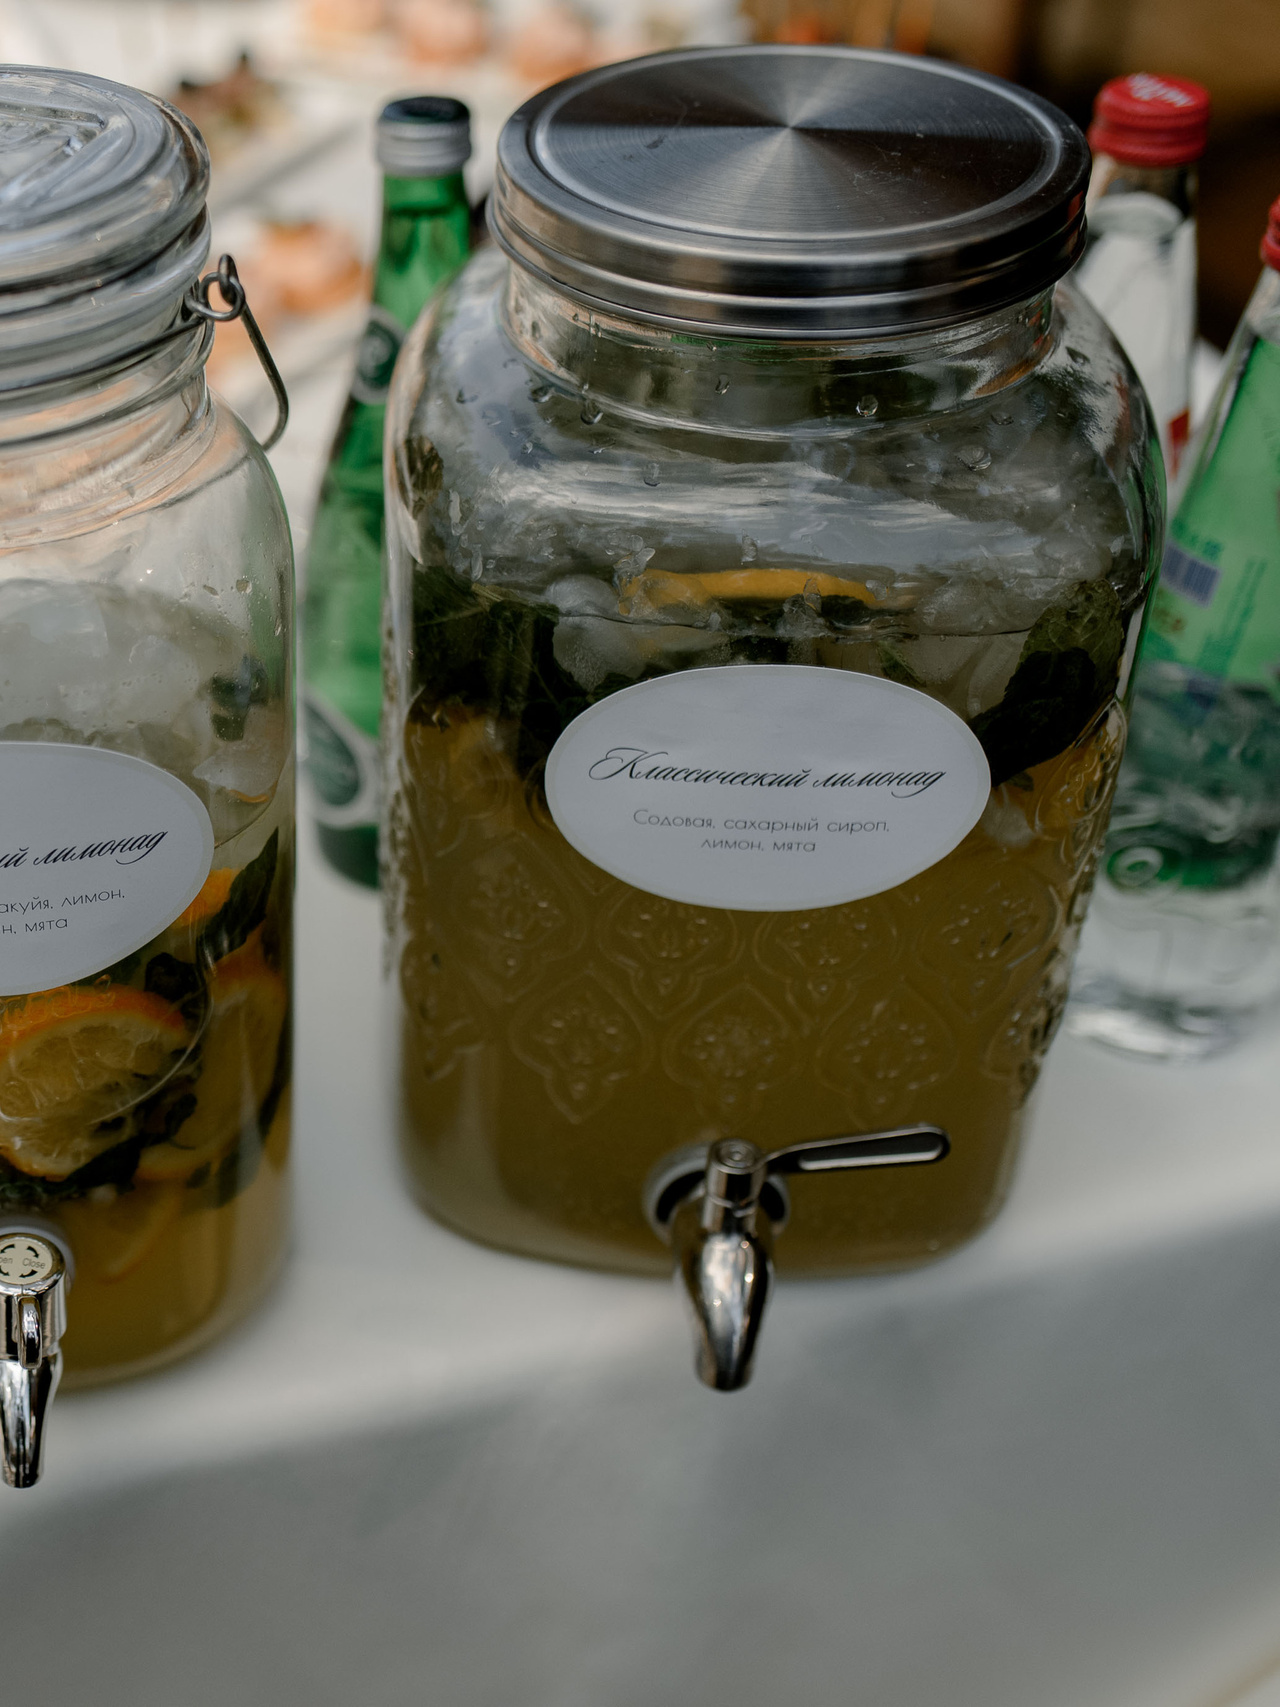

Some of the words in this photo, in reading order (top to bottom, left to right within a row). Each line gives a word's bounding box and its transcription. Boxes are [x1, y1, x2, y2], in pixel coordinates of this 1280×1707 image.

[588, 746, 813, 789] Классический
[812, 770, 947, 799] лимонад
[723, 817, 819, 834] сахарный
[32, 830, 169, 866] лимонад
[772, 841, 816, 853] мята
[24, 918, 68, 933] мята
[22, 1257, 46, 1269] Close
